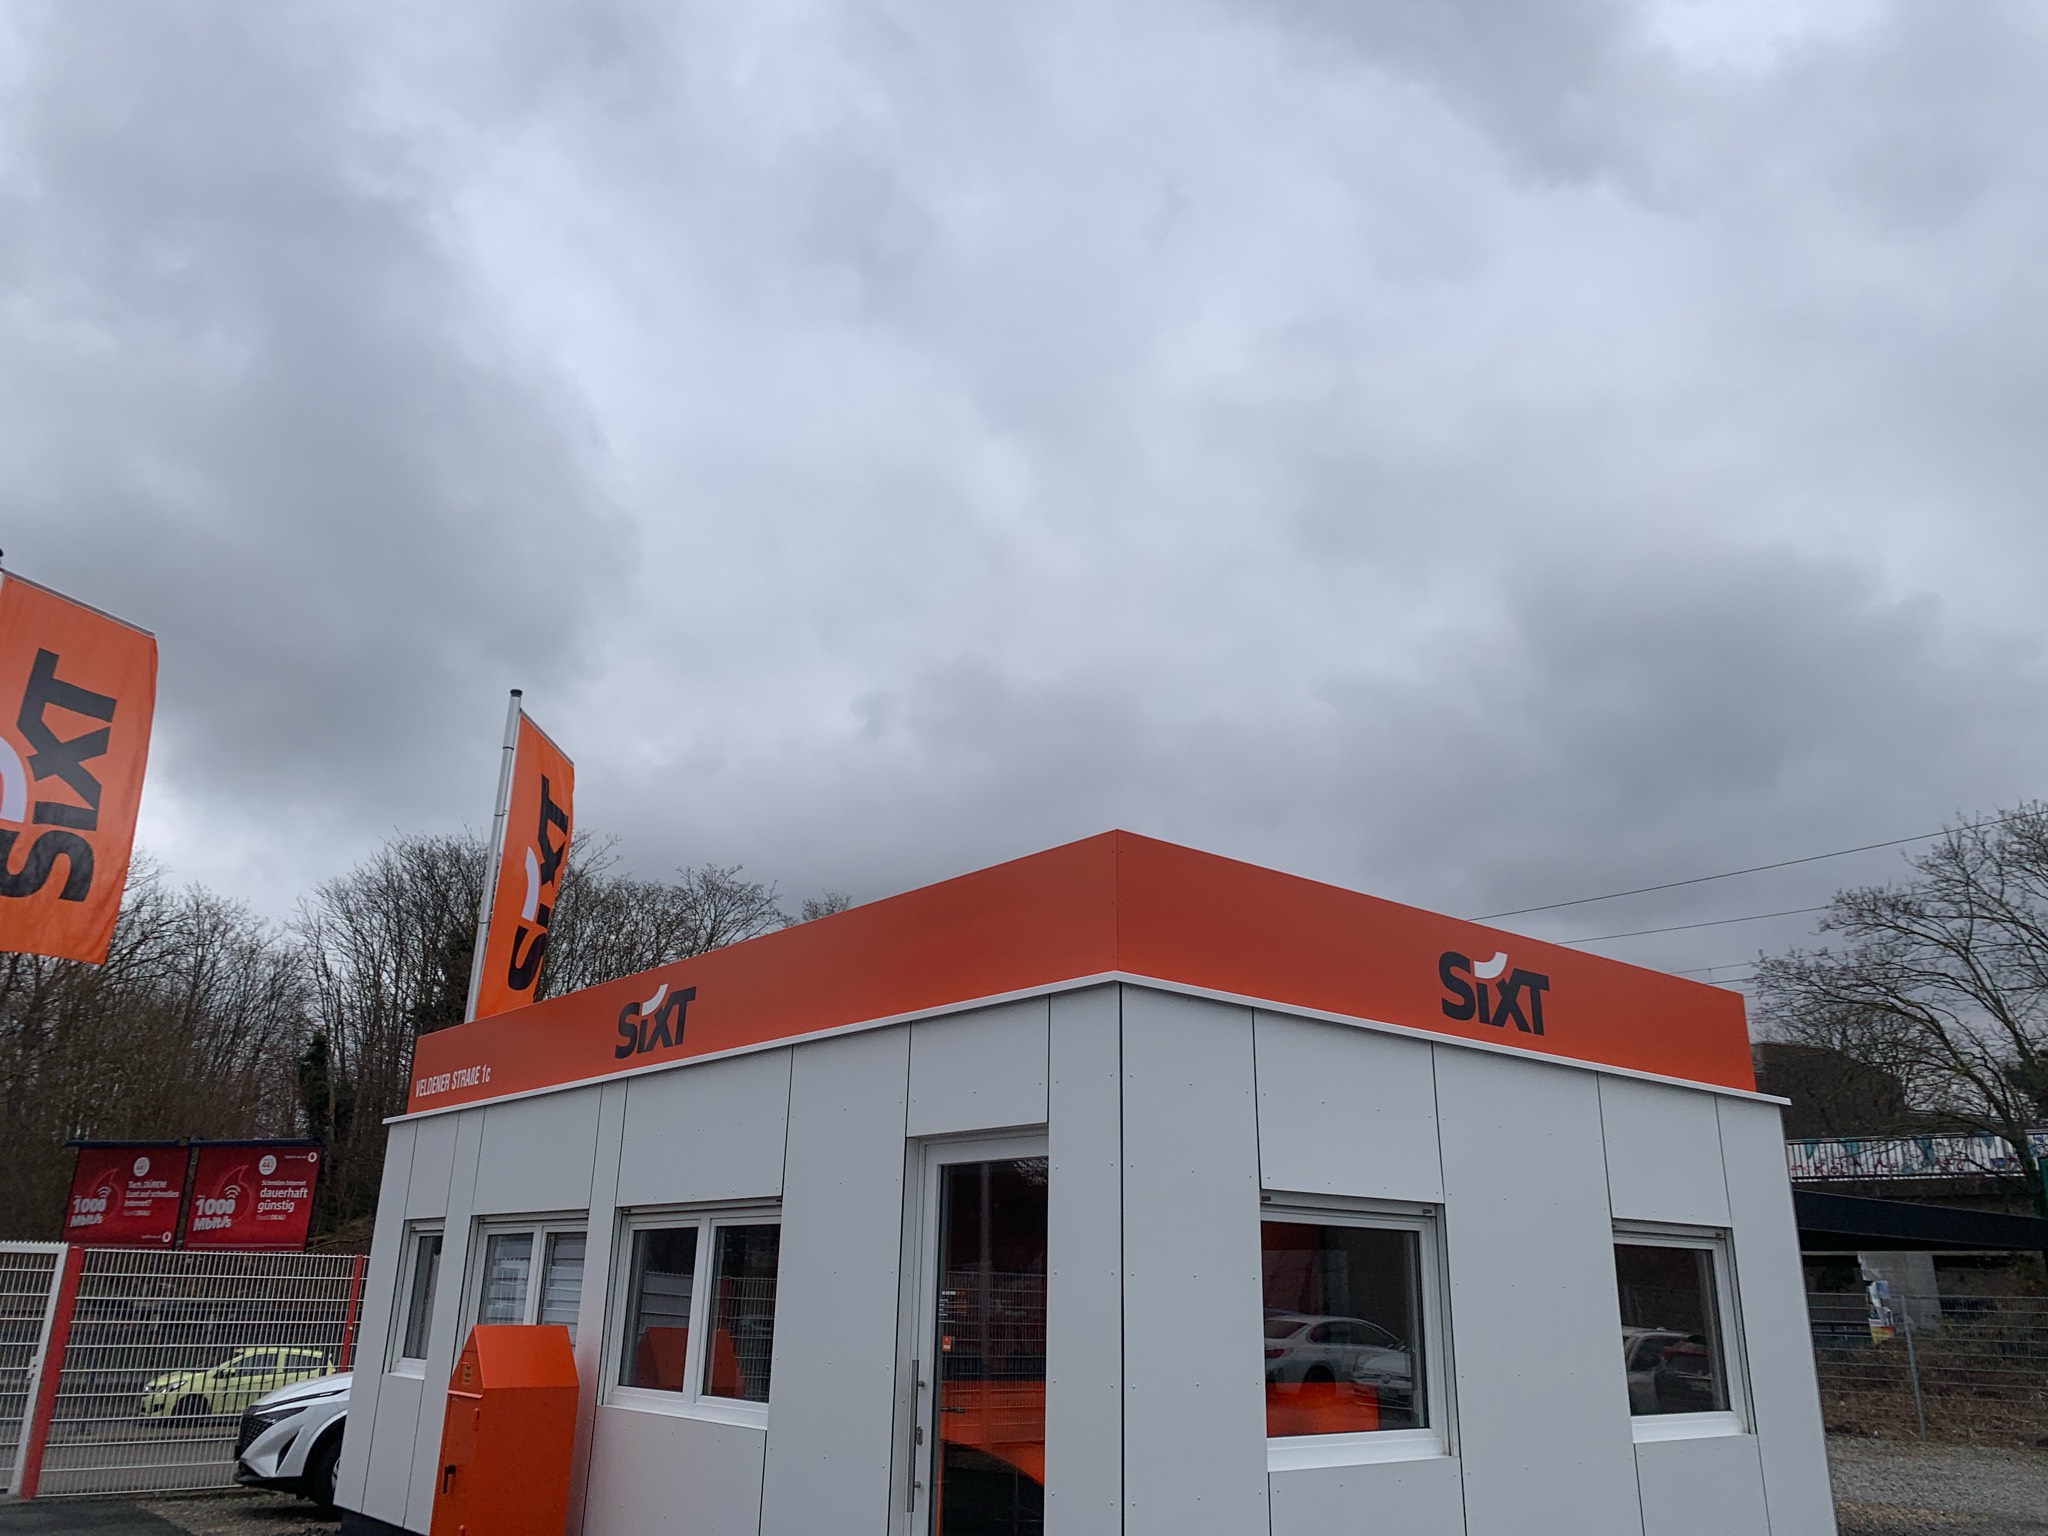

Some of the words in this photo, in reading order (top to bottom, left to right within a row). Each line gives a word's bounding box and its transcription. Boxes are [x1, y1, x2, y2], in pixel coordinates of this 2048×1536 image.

[415, 1073, 451, 1098] VELDENER
[259, 1187, 308, 1198] dauerhaft
[72, 1198, 107, 1214] 1000
[195, 1198, 236, 1216] 1000
[257, 1199, 295, 1213] günstig
